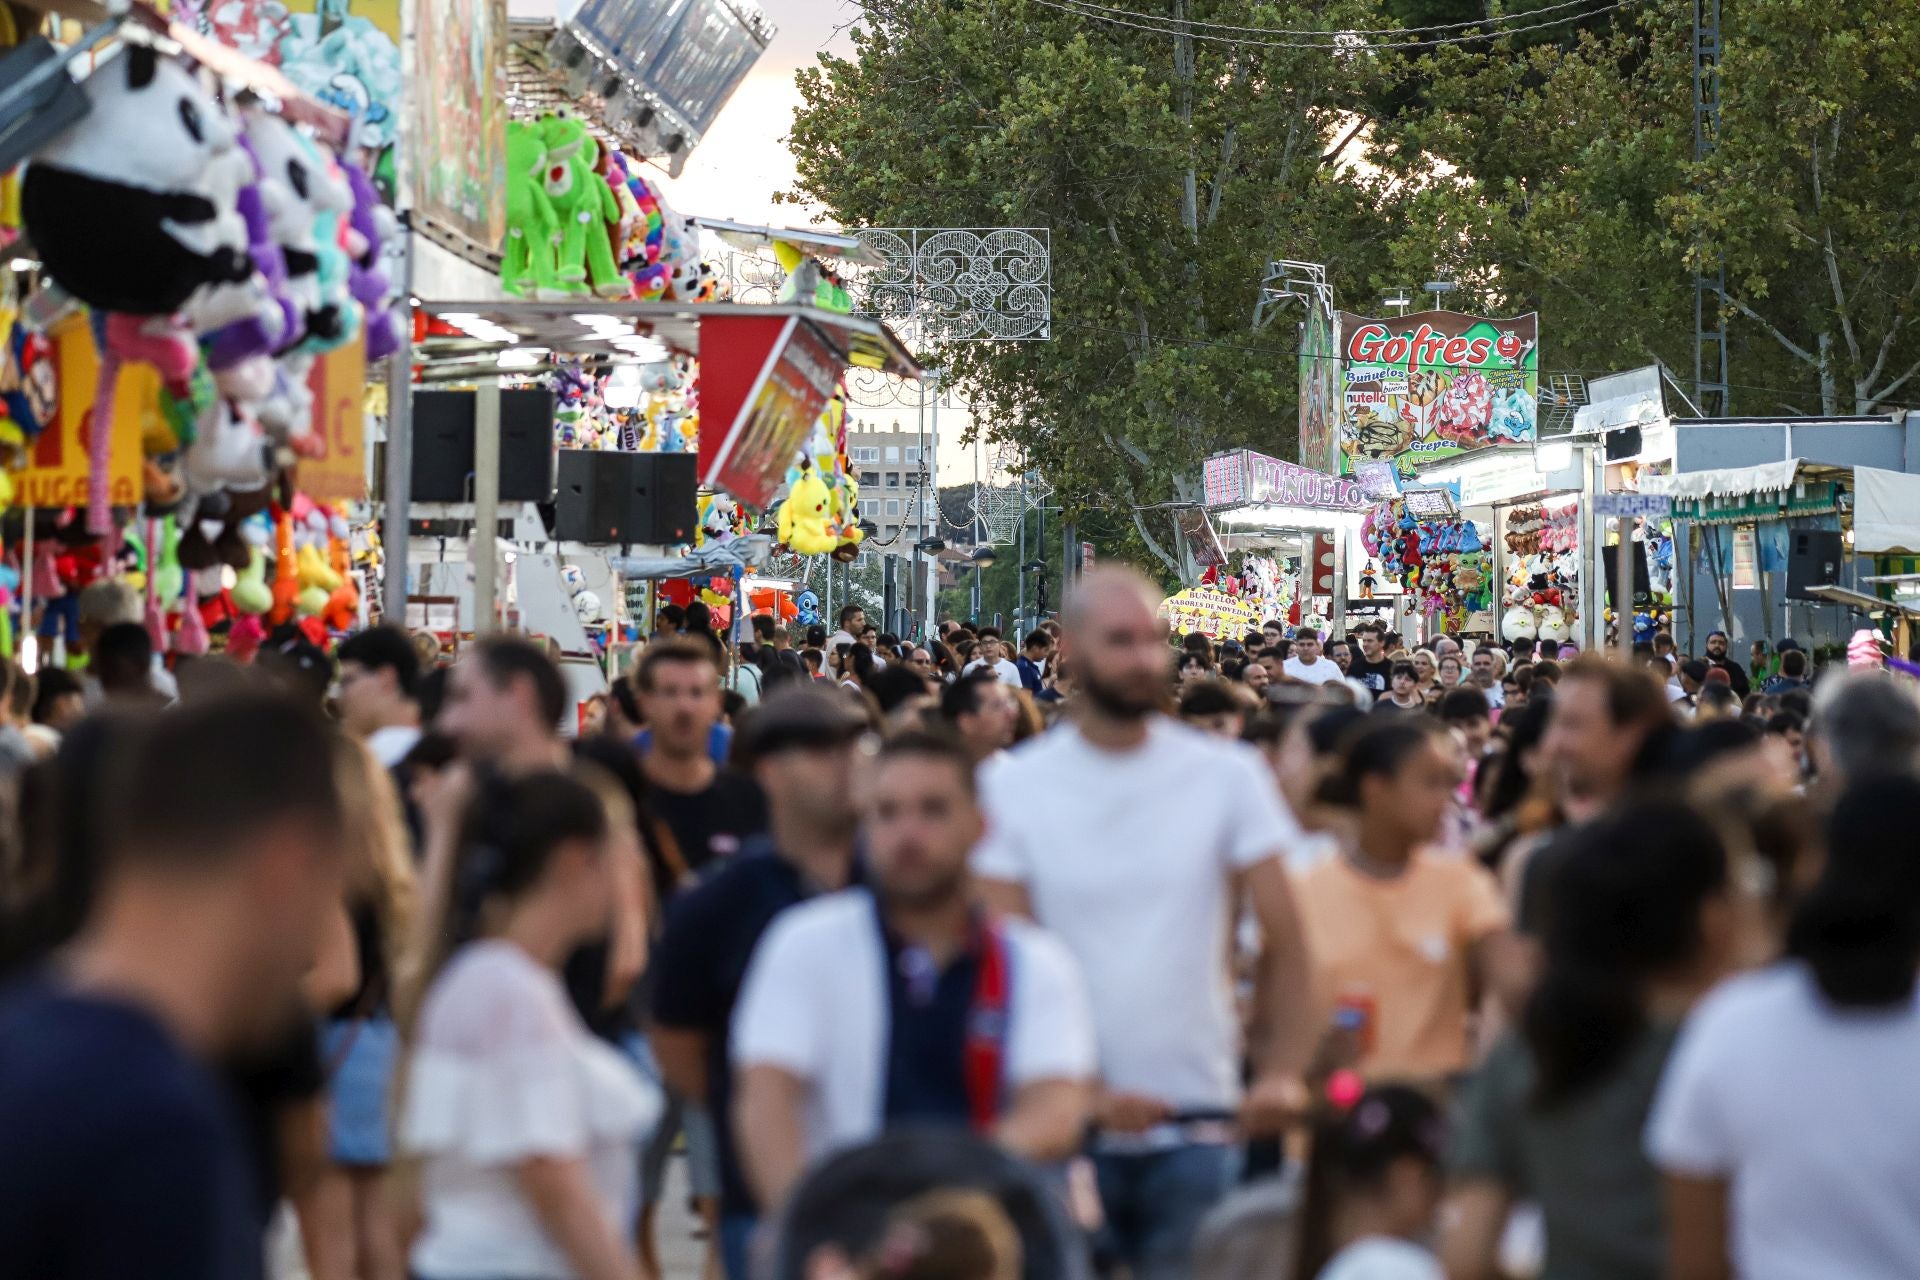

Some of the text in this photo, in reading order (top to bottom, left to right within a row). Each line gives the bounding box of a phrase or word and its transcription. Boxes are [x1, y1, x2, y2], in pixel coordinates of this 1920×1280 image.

[1349, 324, 1492, 373] Gofres
[1346, 367, 1404, 383] Buñuelos
[1346, 392, 1387, 403] nutella
[1383, 385, 1408, 394] bueno
[1410, 440, 1457, 452] Crepes
[1189, 590, 1237, 606] BUÑUELOS
[1169, 599, 1253, 618] SABORES DE NOVEDAD
